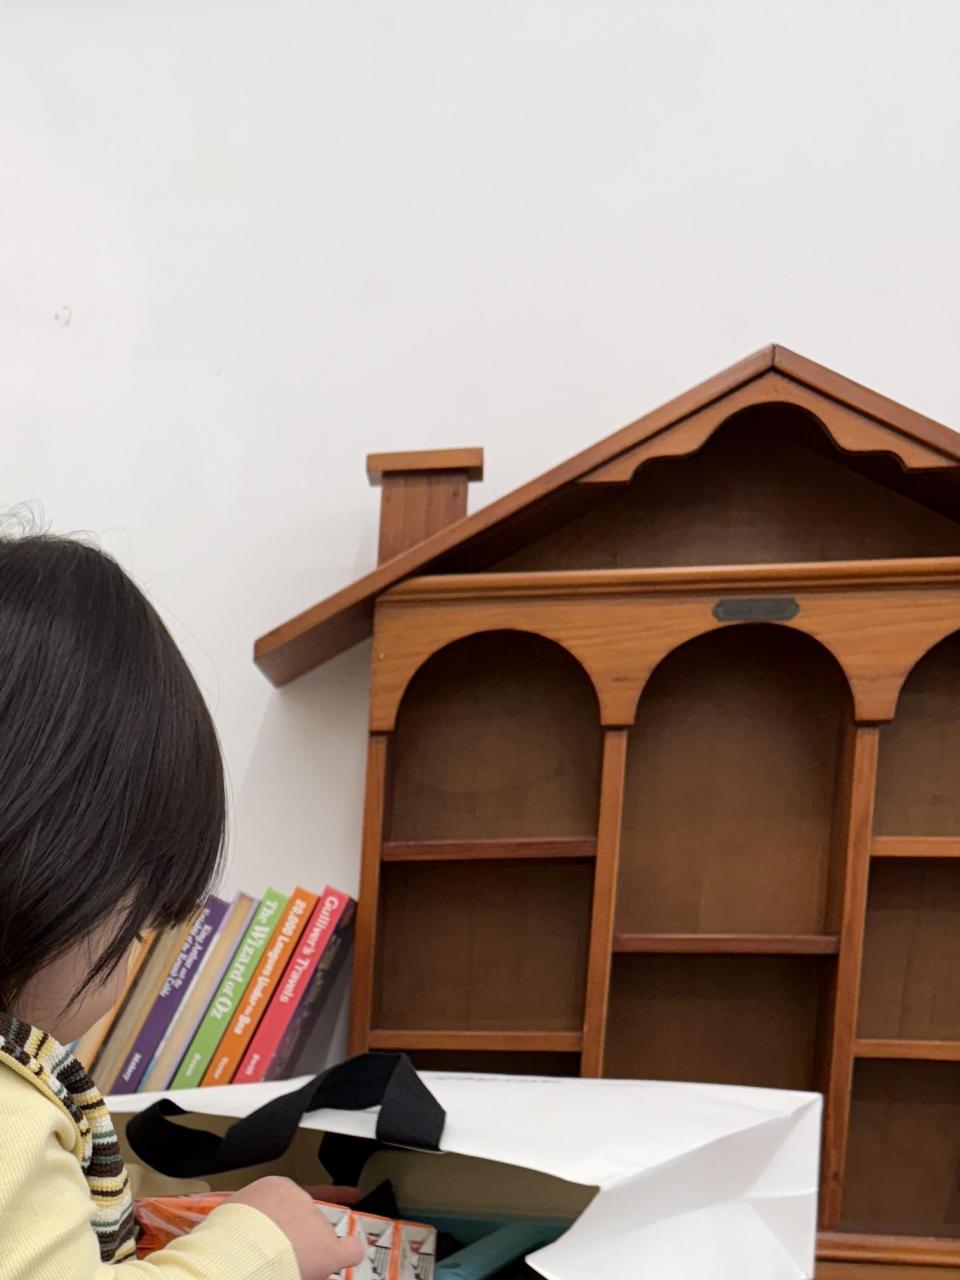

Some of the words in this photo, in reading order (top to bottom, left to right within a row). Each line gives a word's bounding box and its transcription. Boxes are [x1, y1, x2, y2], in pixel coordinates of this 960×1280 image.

[257, 899, 279, 924] The
[302, 895, 339, 955] Gulliver's
[229, 925, 270, 983] Wizard
[222, 980, 235, 998] of
[279, 958, 310, 1003] Travels
[210, 996, 233, 1019] Oz
